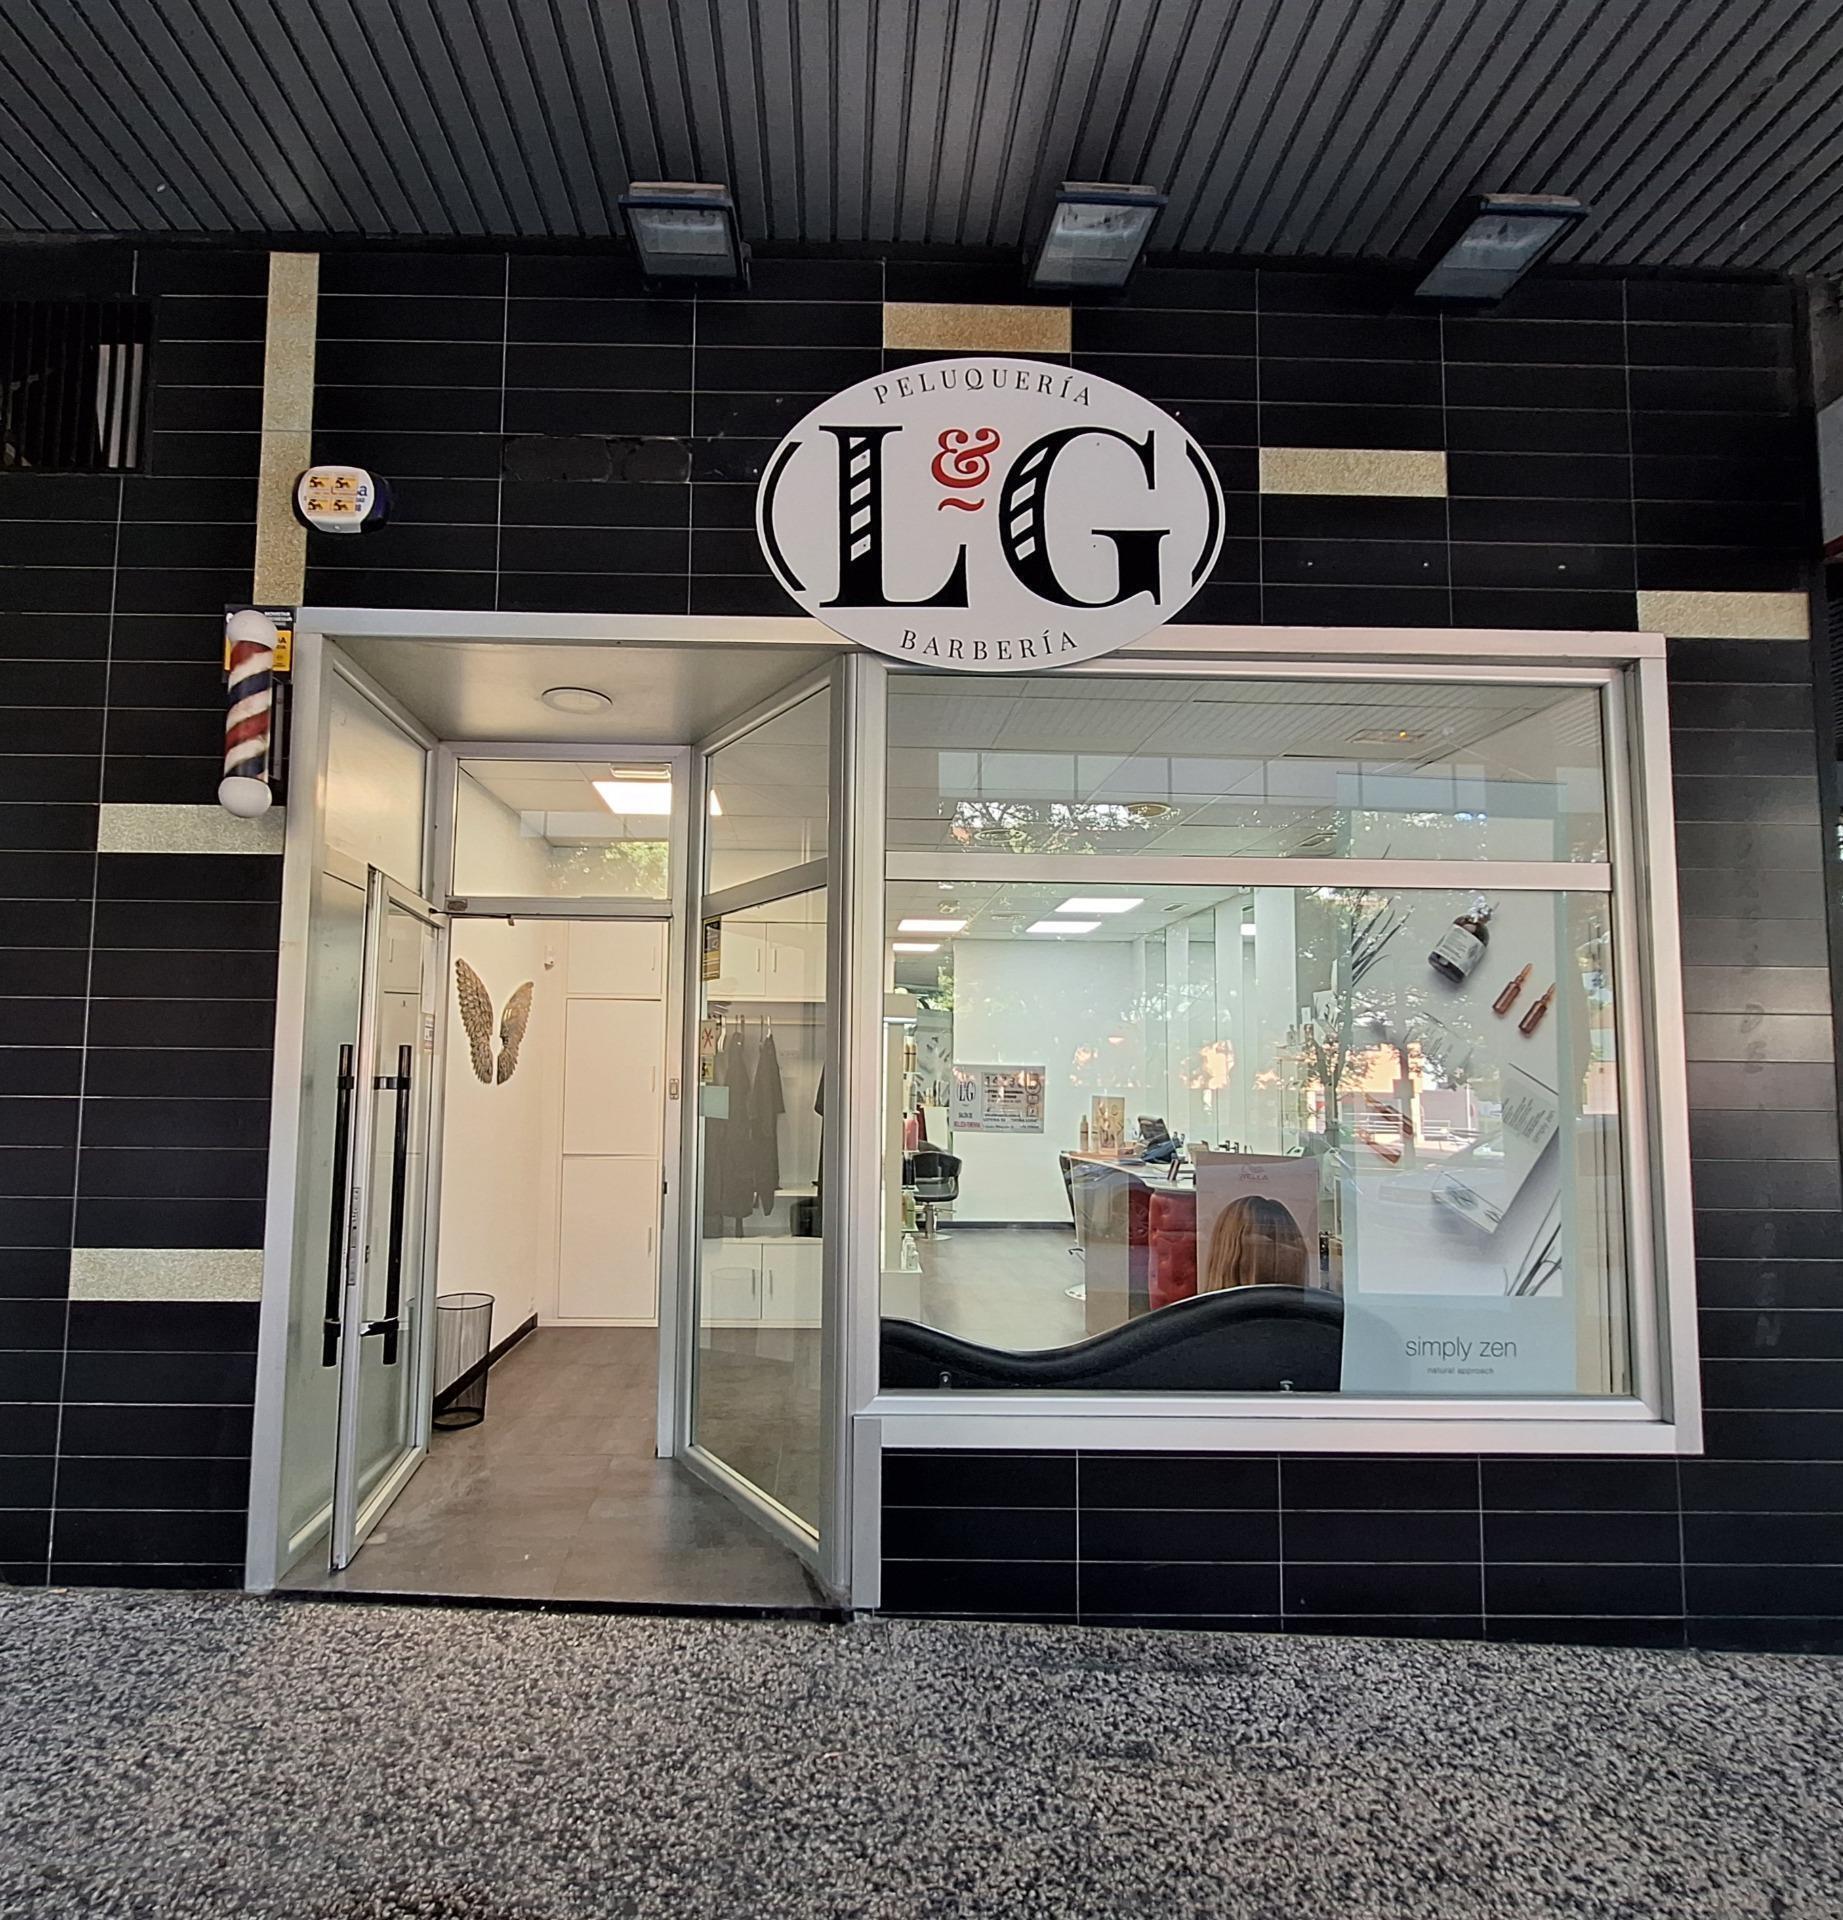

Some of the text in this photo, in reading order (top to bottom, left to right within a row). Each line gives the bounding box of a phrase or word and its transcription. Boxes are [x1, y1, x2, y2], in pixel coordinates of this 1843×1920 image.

[873, 368, 1091, 406] PELUQUERÍA
[900, 629, 1078, 661] BARBERÍA
[1405, 1336, 1517, 1362] simply zen
